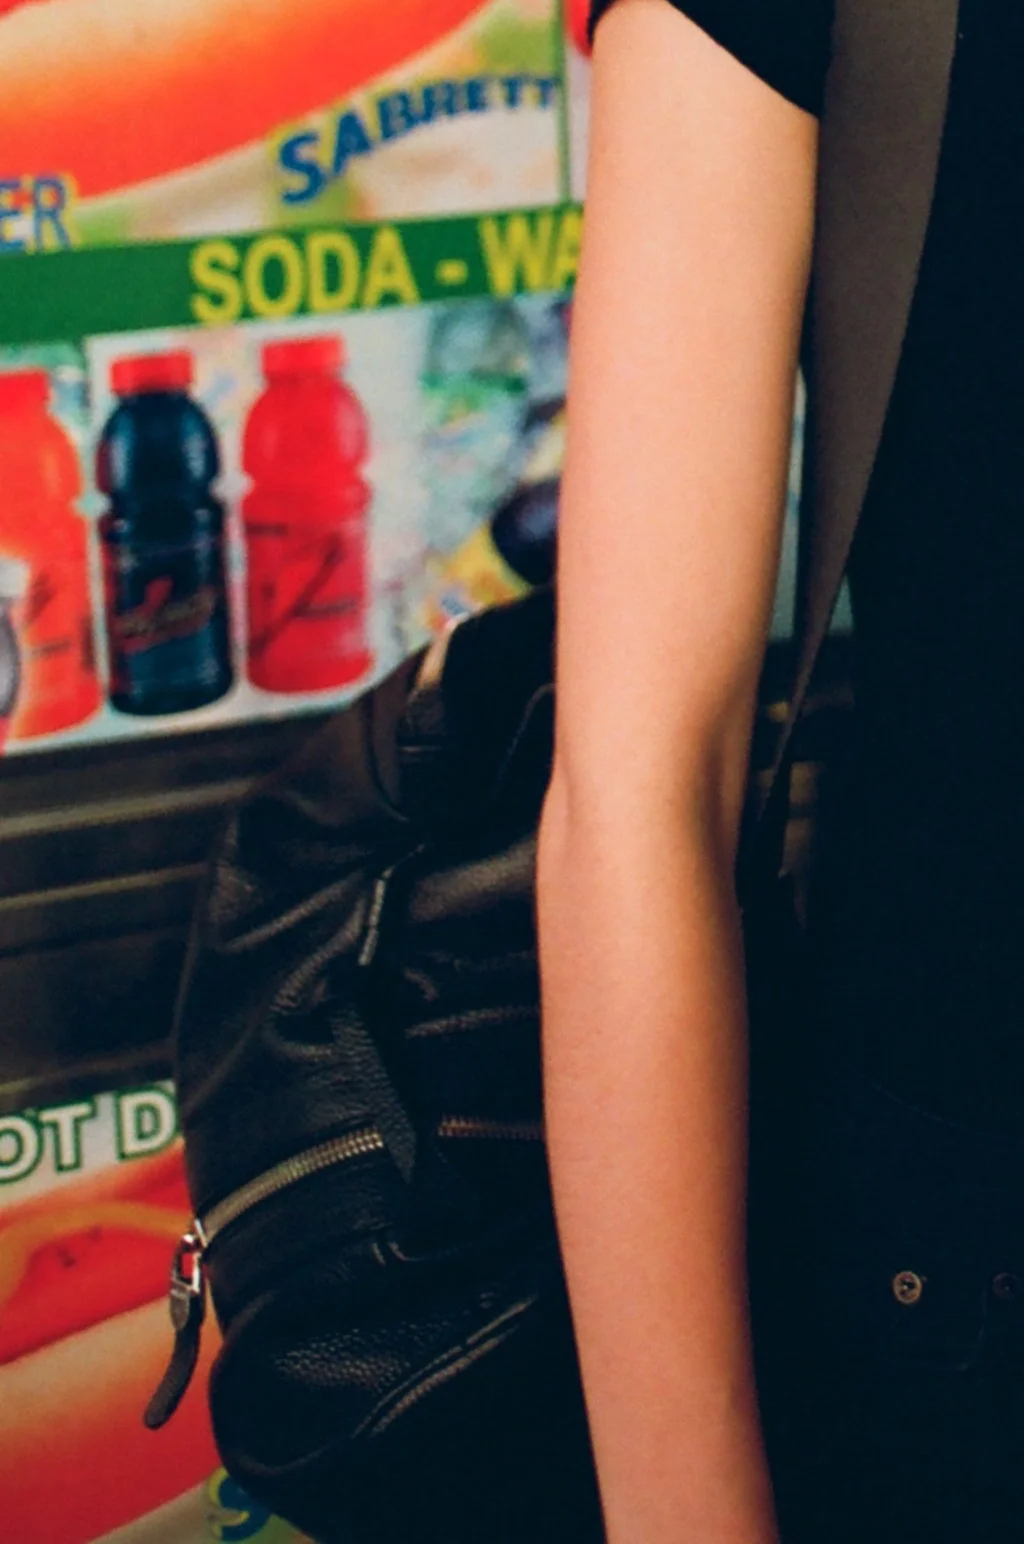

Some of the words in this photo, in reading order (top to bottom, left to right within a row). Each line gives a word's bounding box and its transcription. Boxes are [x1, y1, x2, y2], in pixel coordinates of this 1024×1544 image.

[277, 74, 557, 204] SABRETT
[190, 226, 421, 324] SODA
[435, 259, 468, 284] -
